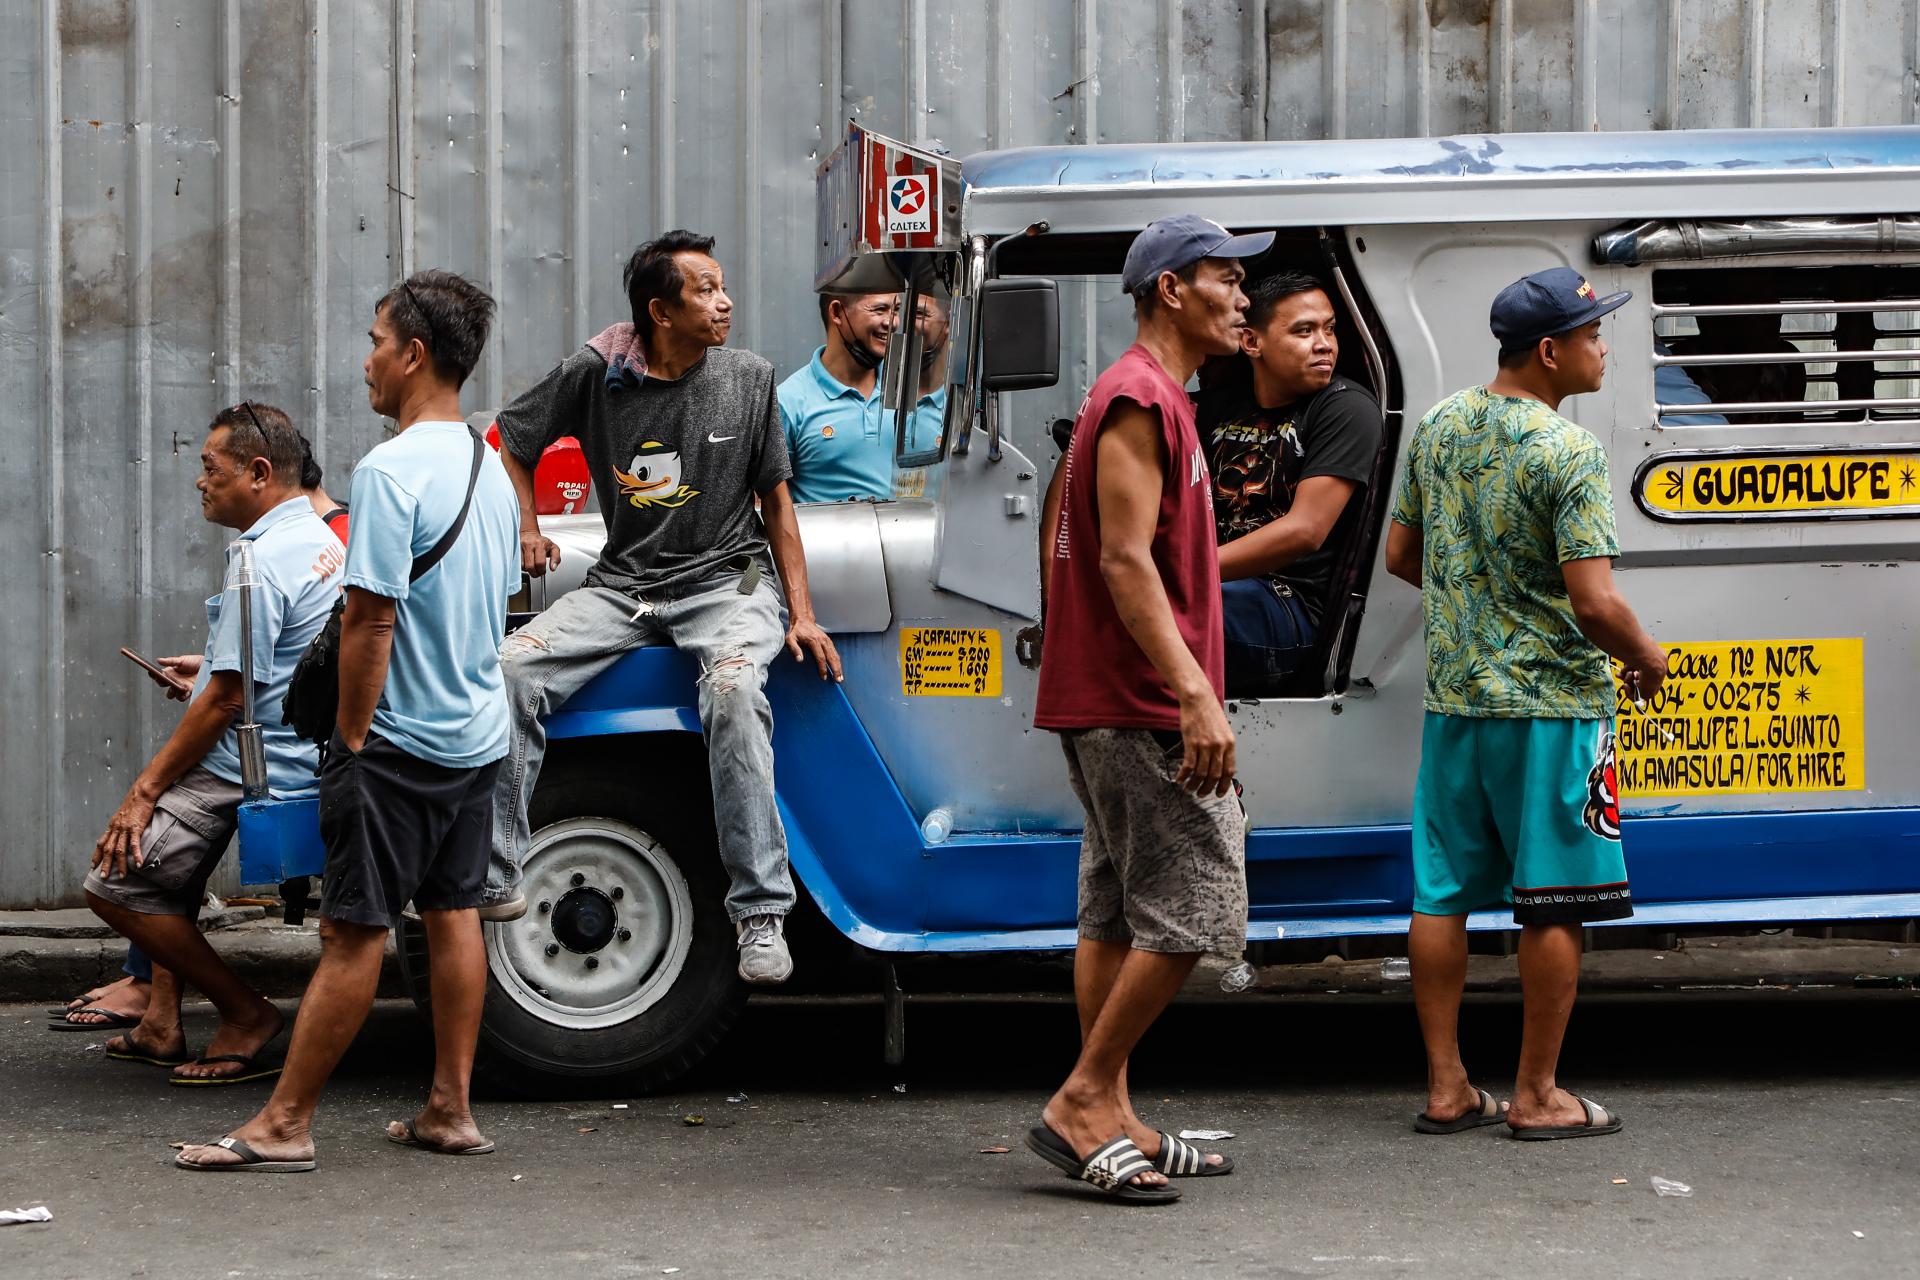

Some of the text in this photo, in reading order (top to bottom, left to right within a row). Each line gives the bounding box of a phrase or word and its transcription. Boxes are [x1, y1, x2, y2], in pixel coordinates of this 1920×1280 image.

[890, 221, 927, 231] CALTEX
[1693, 461, 1890, 506] GUADALUPE
[923, 629, 976, 646] CAPACITY
[1666, 648, 1718, 680] Case
[1765, 645, 1822, 679] NCR
[974, 677, 986, 694] 21
[1797, 752, 1846, 788] HIRE
